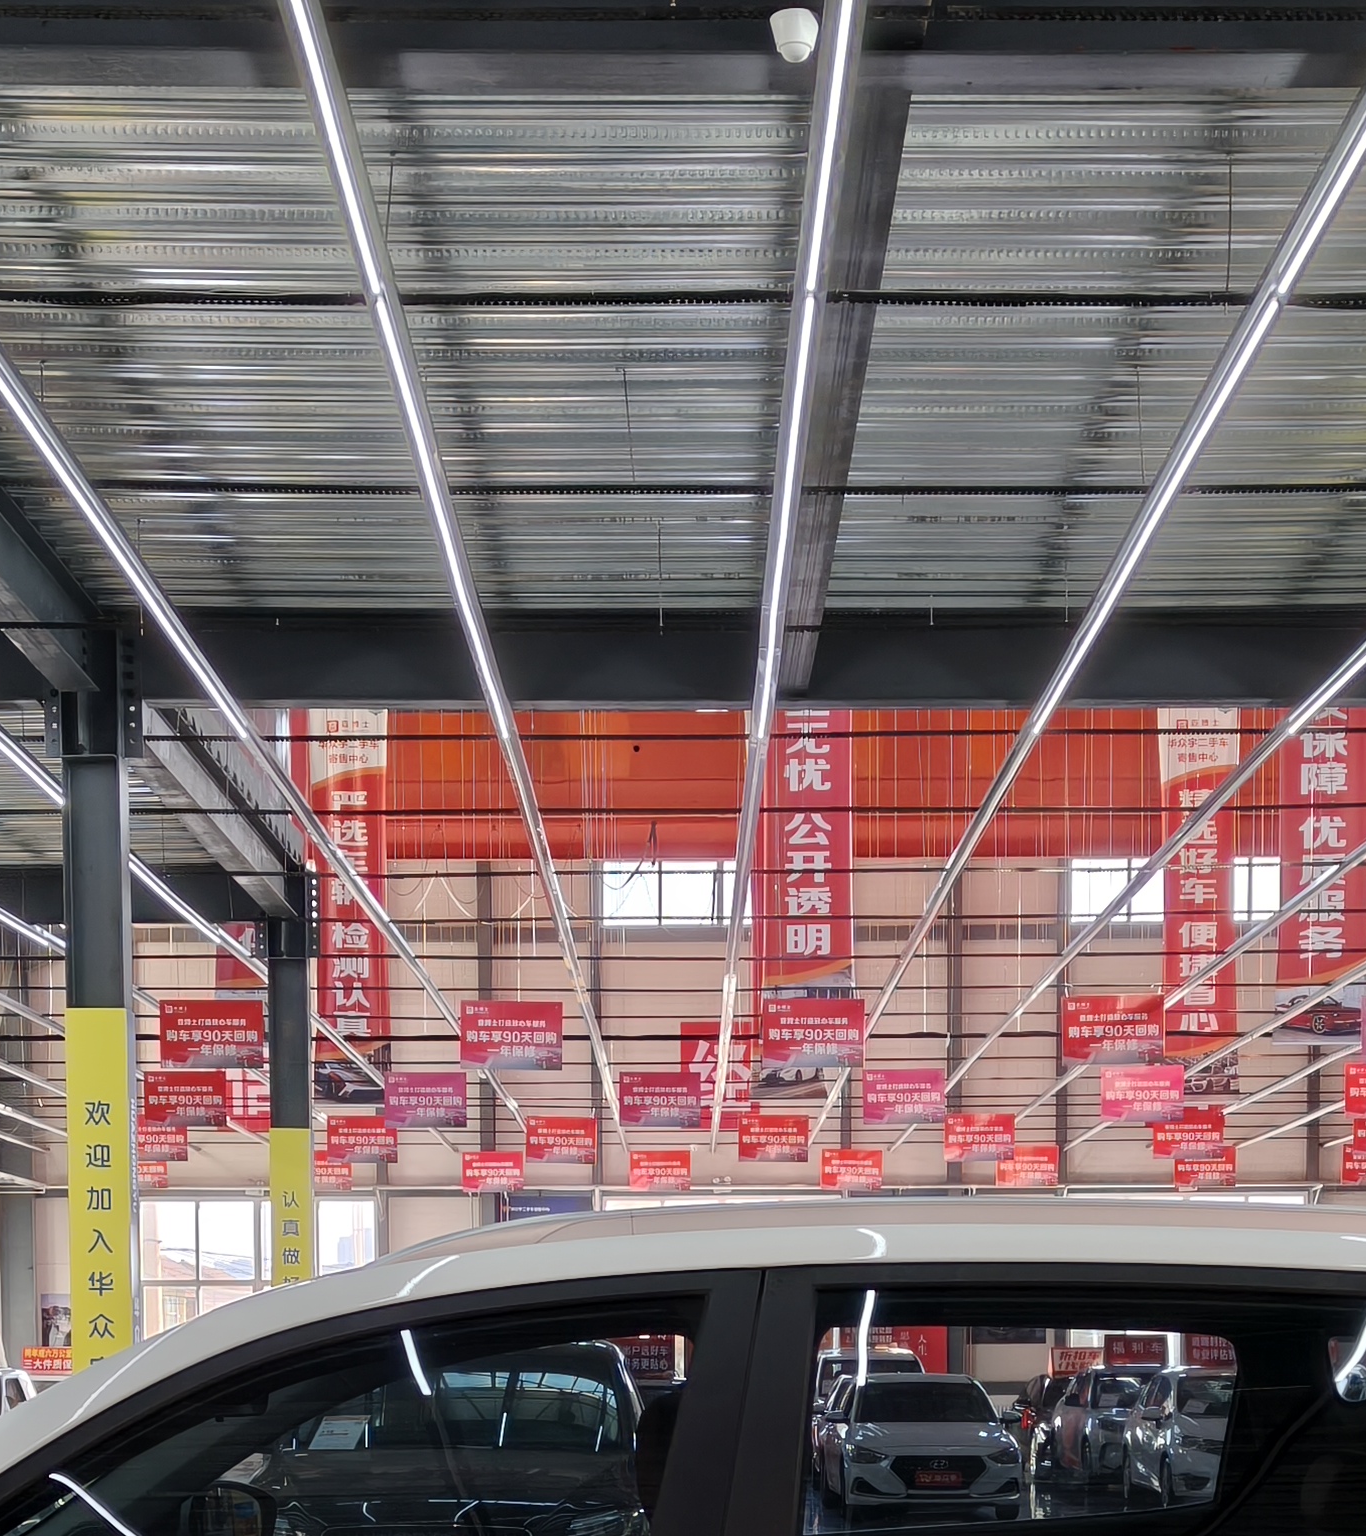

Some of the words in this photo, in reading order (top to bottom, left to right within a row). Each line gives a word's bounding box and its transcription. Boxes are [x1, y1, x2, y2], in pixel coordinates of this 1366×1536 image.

[784, 710, 832, 792] 无忧
[784, 813, 832, 955] 公开透明
[166, 1030, 258, 1042] 购车享90天回购
[466, 1030, 557, 1044] 购车享90天回购
[768, 1028, 859, 1041] 购车享90天回购
[1068, 1024, 1160, 1038] 购车享90天回购
[187, 1044, 237, 1056] 一年保修
[789, 1043, 838, 1055] 一年保修
[1089, 1039, 1138, 1051] 一年保修
[487, 1045, 536, 1058] 一年保修
[148, 1095, 223, 1105] 购车享90天回购
[389, 1096, 463, 1106] 购车享90天回购
[623, 1096, 697, 1106] 购车享90天回购
[867, 1092, 941, 1103] 购车享90天回购
[1105, 1090, 1180, 1101] 购车享90天回购
[84, 1101, 115, 1364] 欢迎加入华众
